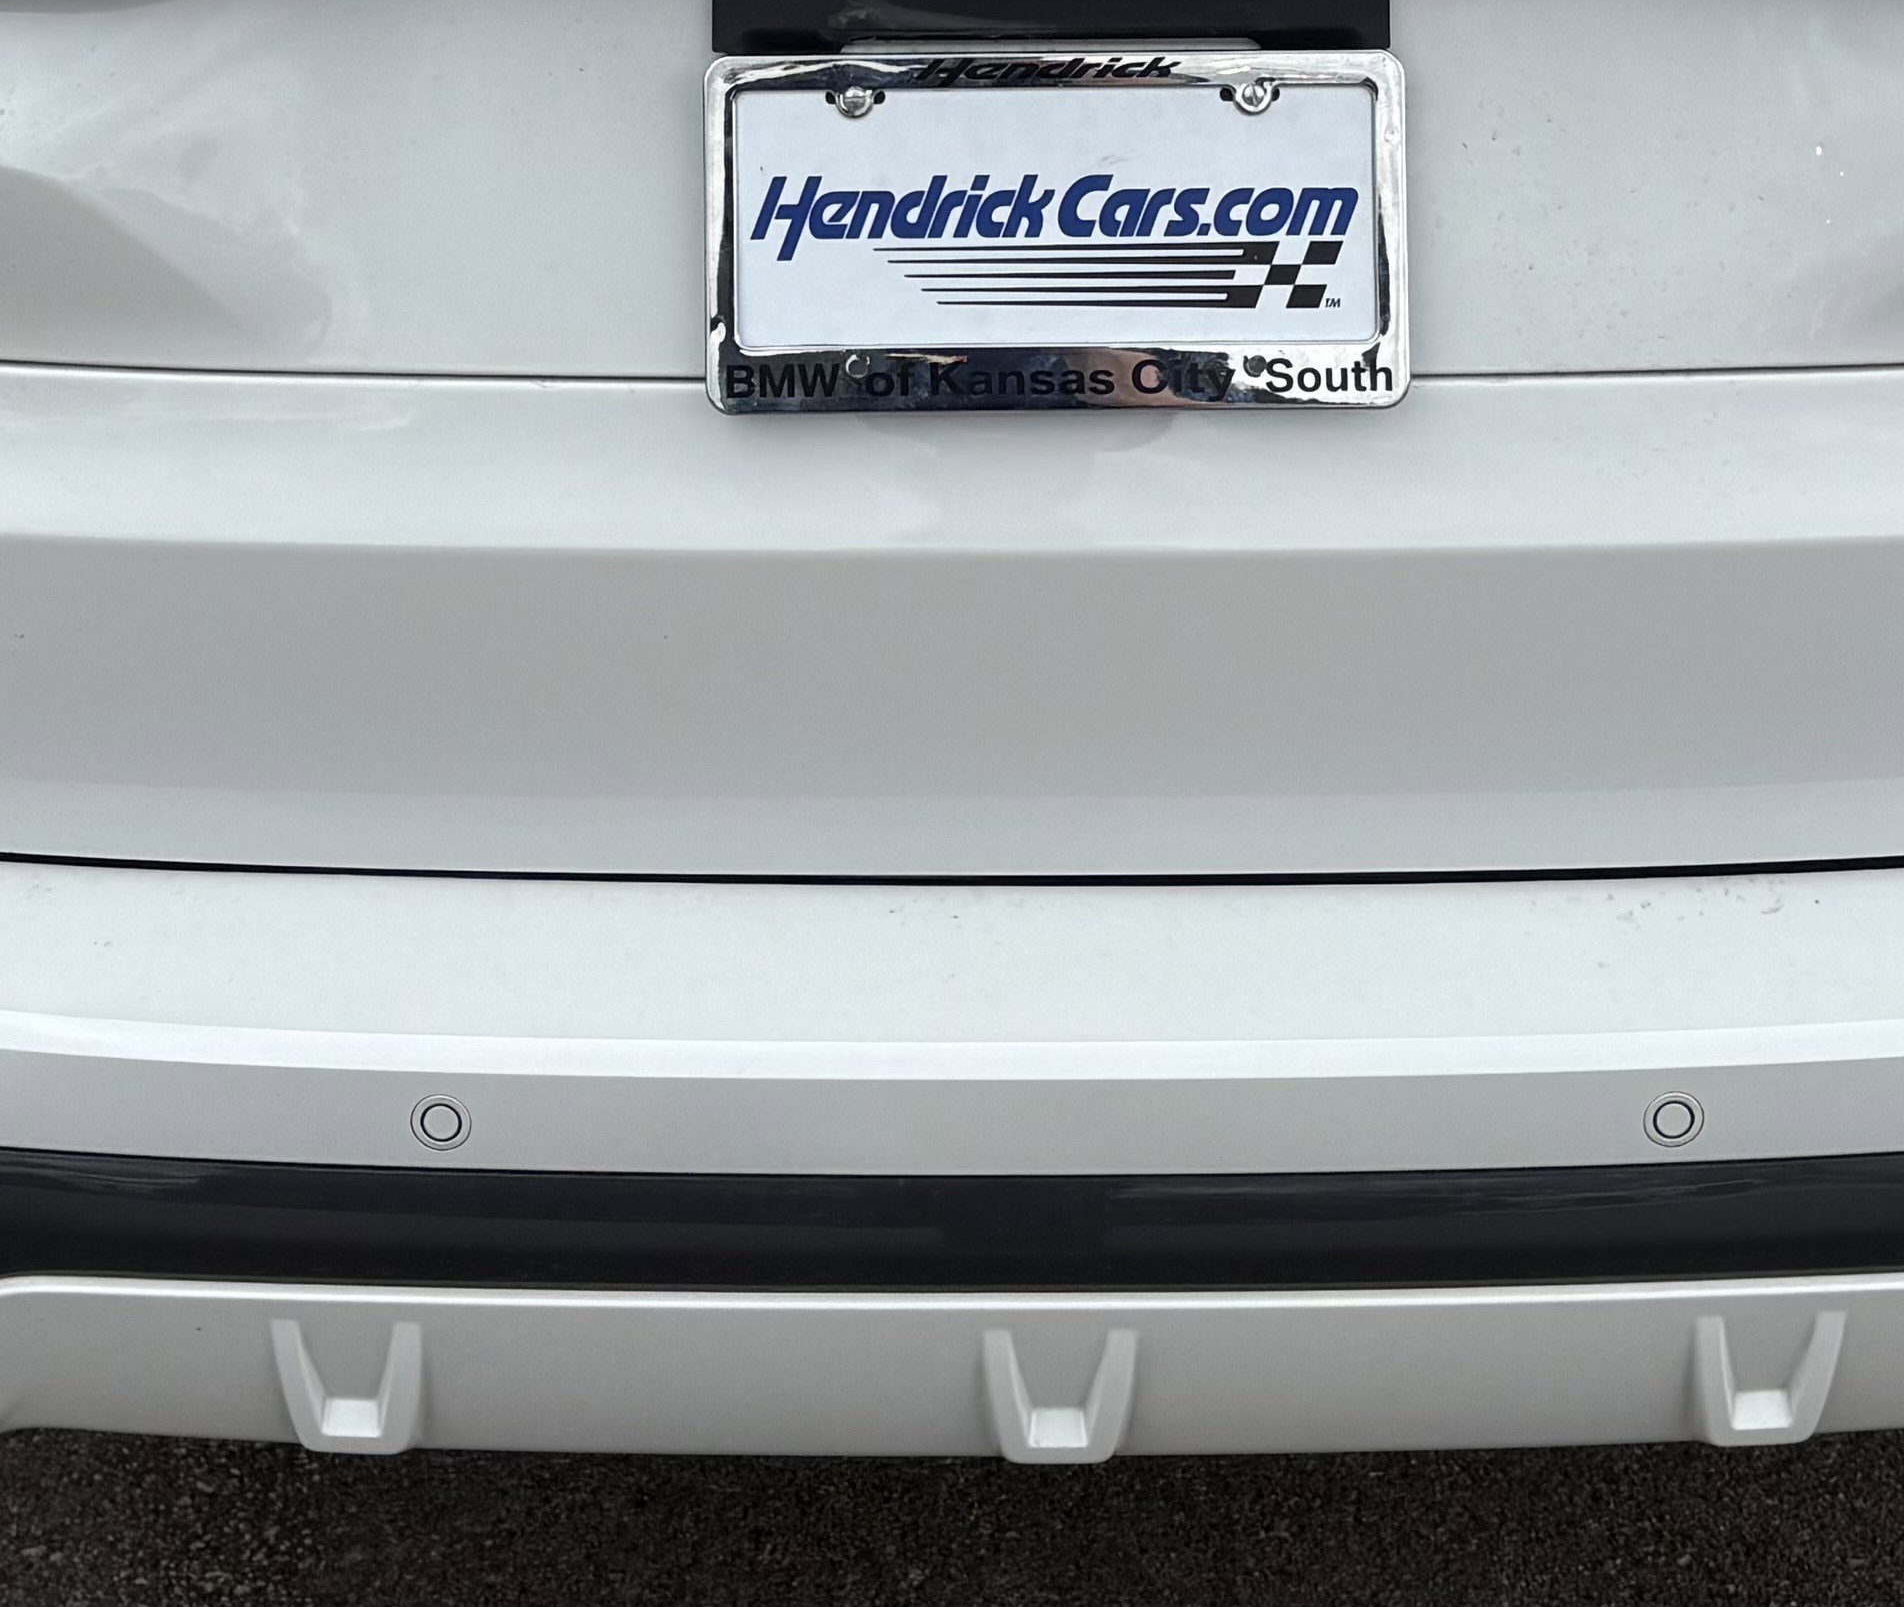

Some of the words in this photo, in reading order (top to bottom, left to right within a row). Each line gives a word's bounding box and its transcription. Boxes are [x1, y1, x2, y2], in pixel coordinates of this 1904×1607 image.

[914, 56, 1181, 87] Hendrick
[1325, 297, 1341, 309] TM
[725, 362, 841, 400] BMW
[865, 364, 920, 398] of
[930, 360, 1115, 397] Kansas
[1131, 357, 1236, 402] City
[1264, 356, 1394, 394] South
